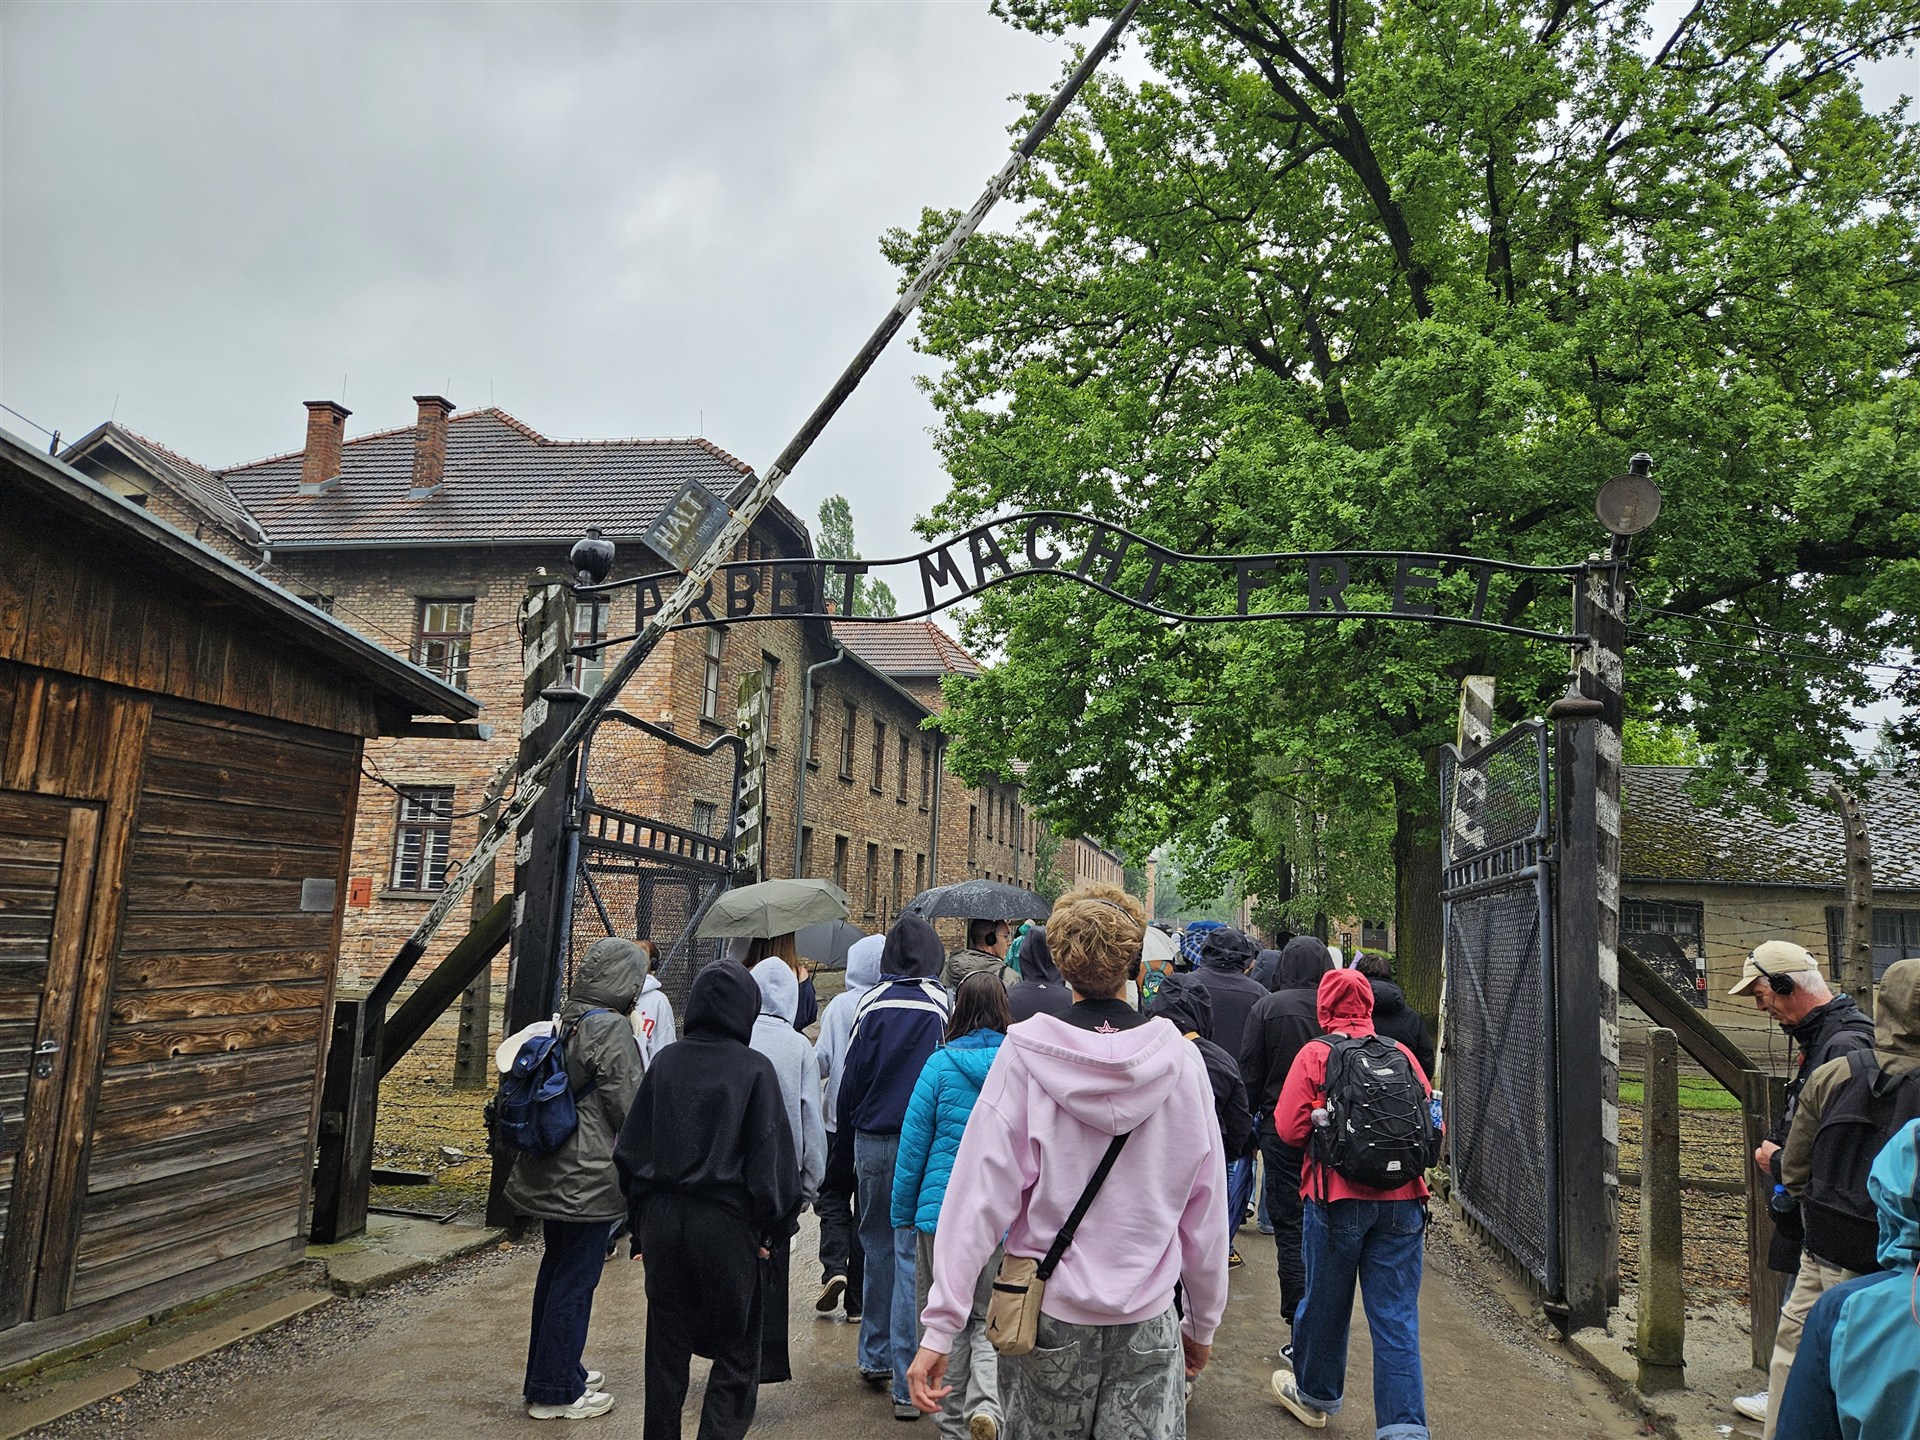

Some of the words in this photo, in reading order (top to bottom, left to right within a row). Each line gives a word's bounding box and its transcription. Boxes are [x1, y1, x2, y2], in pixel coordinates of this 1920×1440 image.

[653, 490, 704, 550] HALT
[635, 561, 868, 633] ARBEIT
[918, 515, 1180, 606] MACHT
[1237, 556, 1492, 623] FREI
